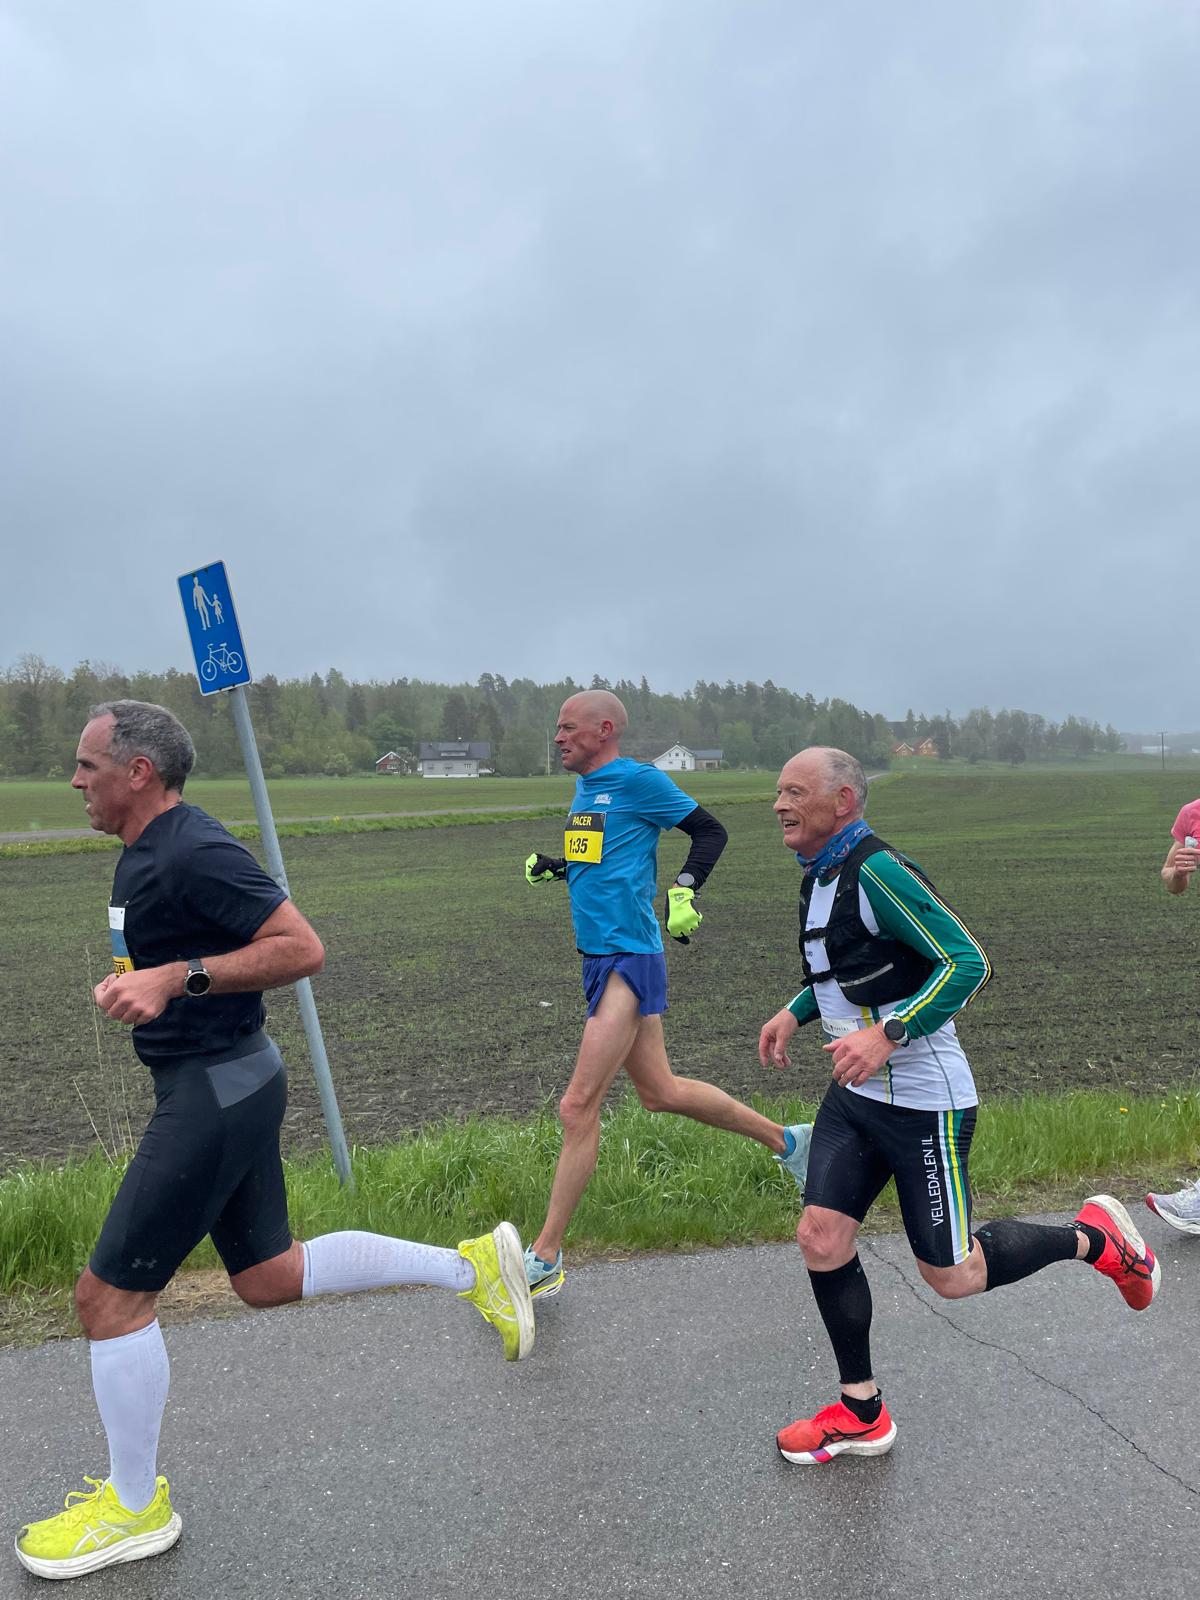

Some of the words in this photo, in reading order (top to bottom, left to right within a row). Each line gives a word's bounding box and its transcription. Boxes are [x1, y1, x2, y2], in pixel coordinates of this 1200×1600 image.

[572, 815, 592, 826] PACER
[569, 838, 589, 854] 1:35
[921, 1135, 933, 1145] IL
[923, 1149, 944, 1227] VELLEDALEN
